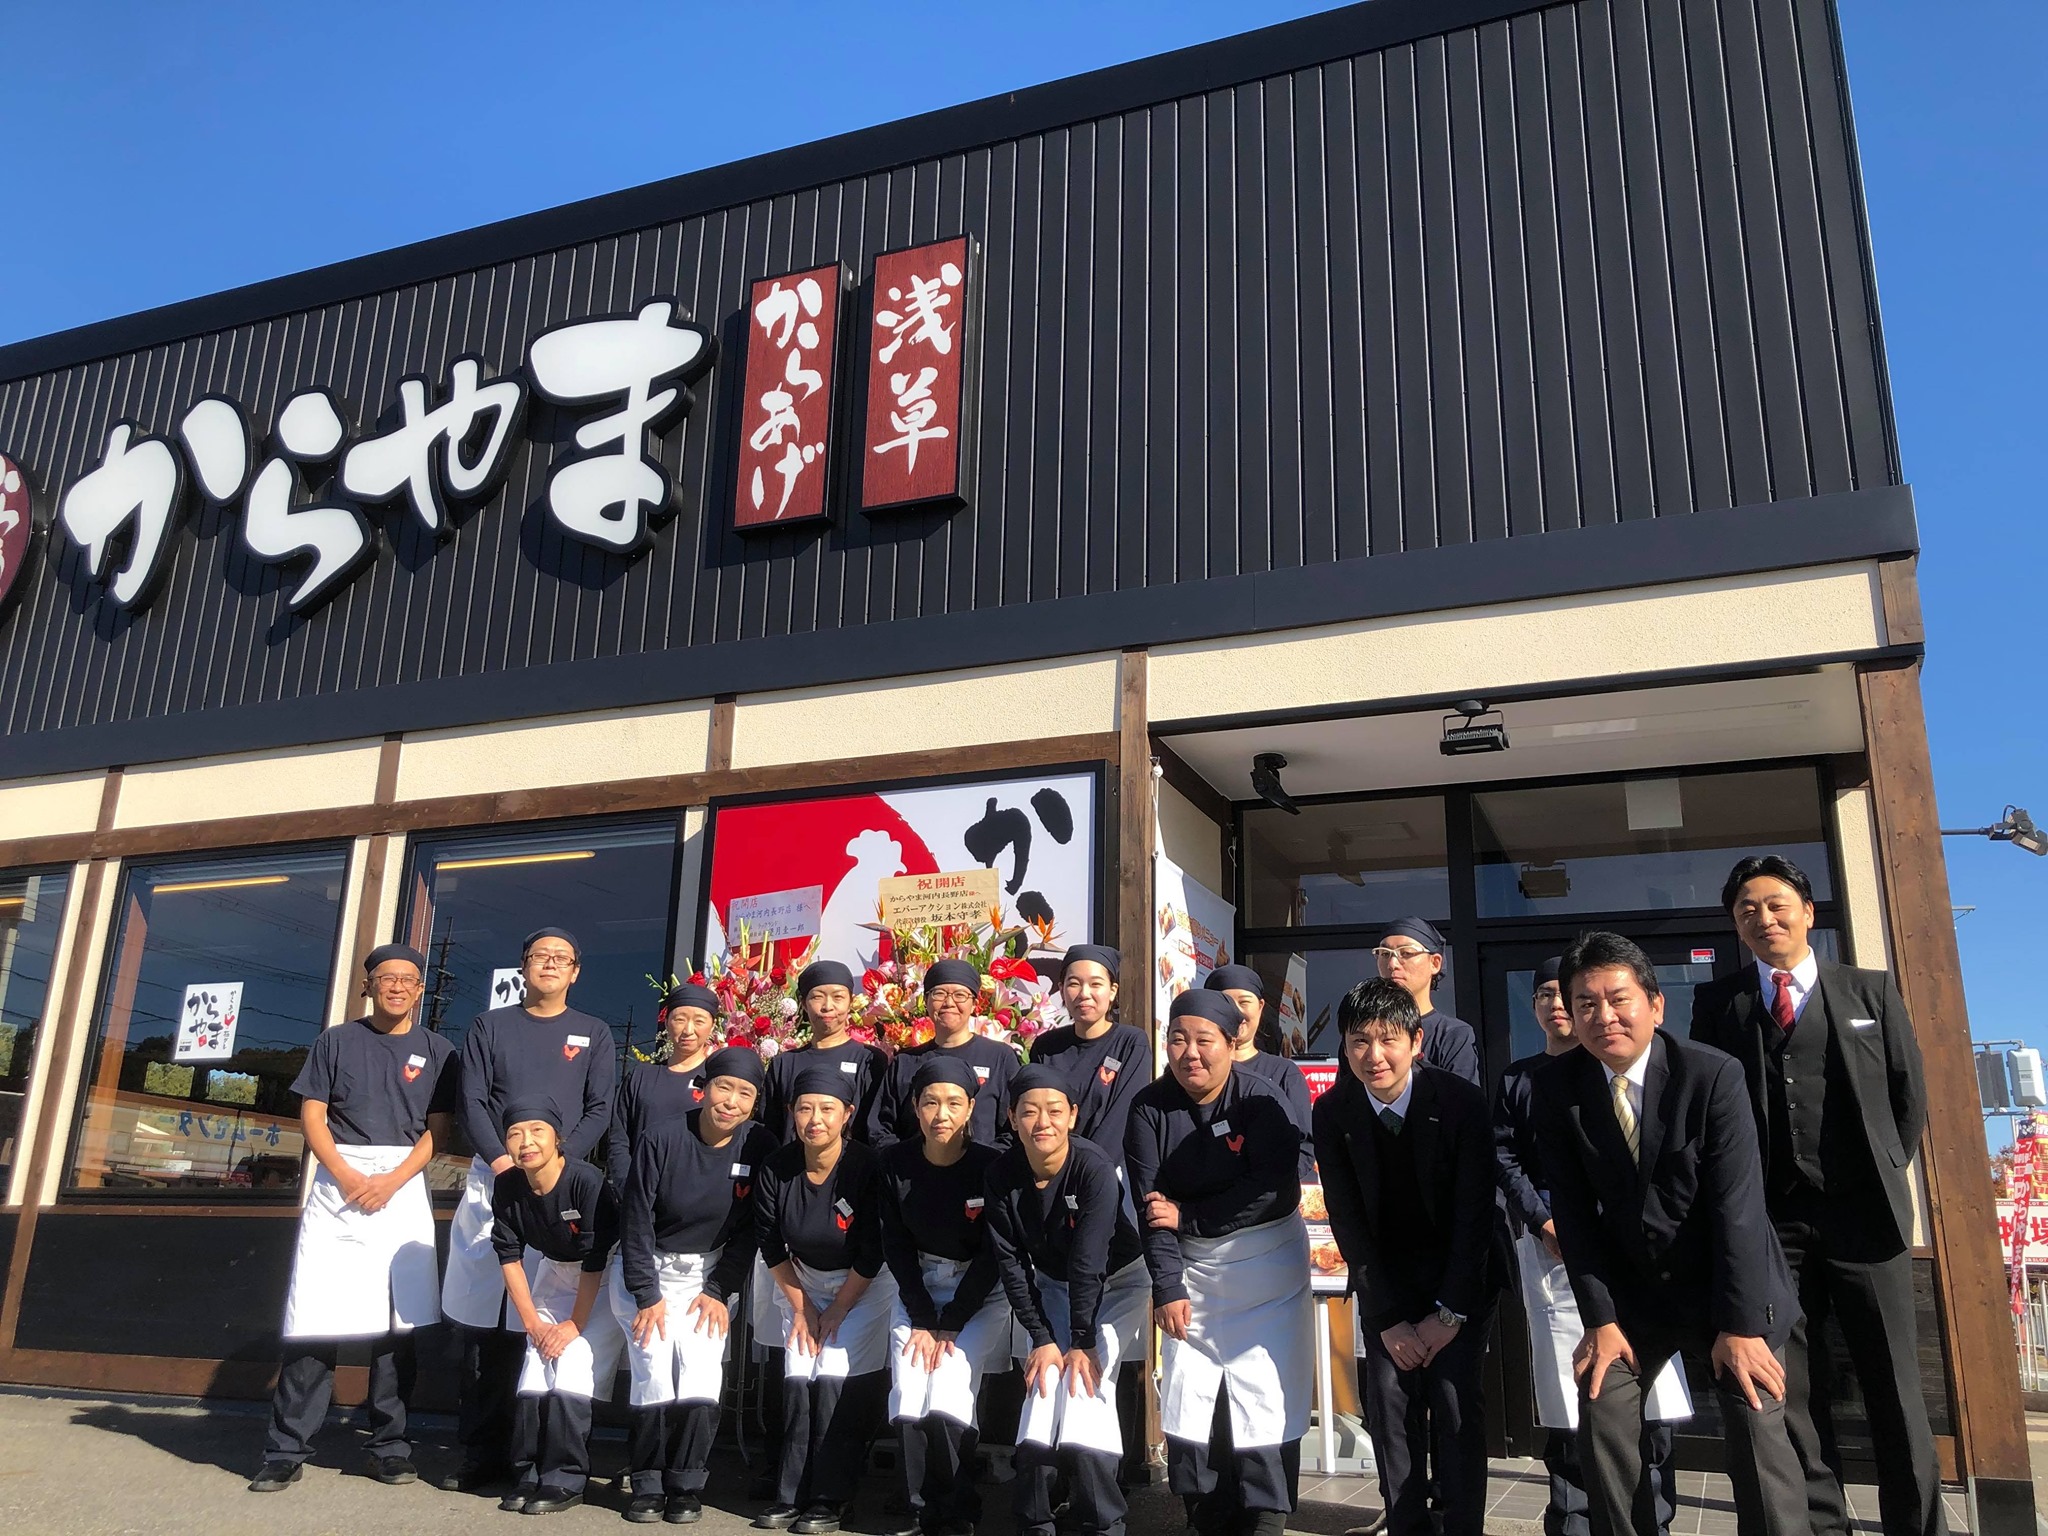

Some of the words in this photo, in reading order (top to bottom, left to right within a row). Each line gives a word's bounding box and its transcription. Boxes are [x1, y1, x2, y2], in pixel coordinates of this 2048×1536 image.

[63, 301, 704, 606] からやま
[750, 277, 825, 520] からあげ
[872, 262, 962, 476] 浅草
[917, 876, 966, 890] 祝開店
